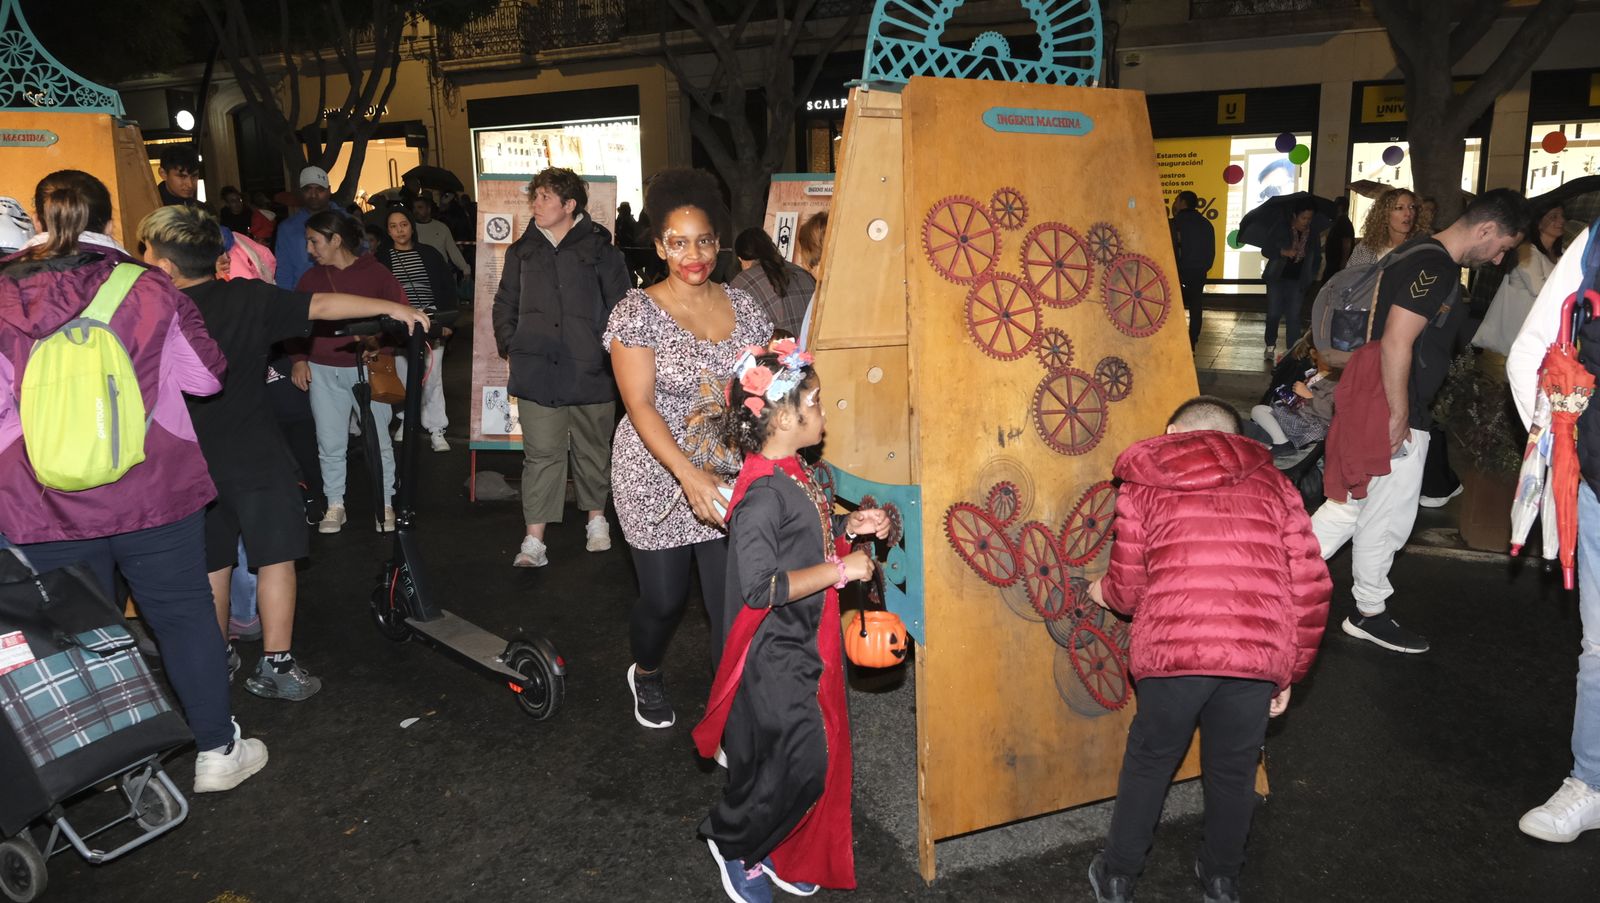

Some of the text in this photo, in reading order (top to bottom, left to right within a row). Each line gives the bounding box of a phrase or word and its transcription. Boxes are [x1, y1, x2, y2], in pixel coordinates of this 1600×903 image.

[806, 98, 848, 110] SCALP
[1376, 104, 1406, 117] UNIV
[1226, 103, 1237, 119] U
[996, 114, 1082, 128] INGENII MACHINA
[3, 133, 46, 142] MACHINA
